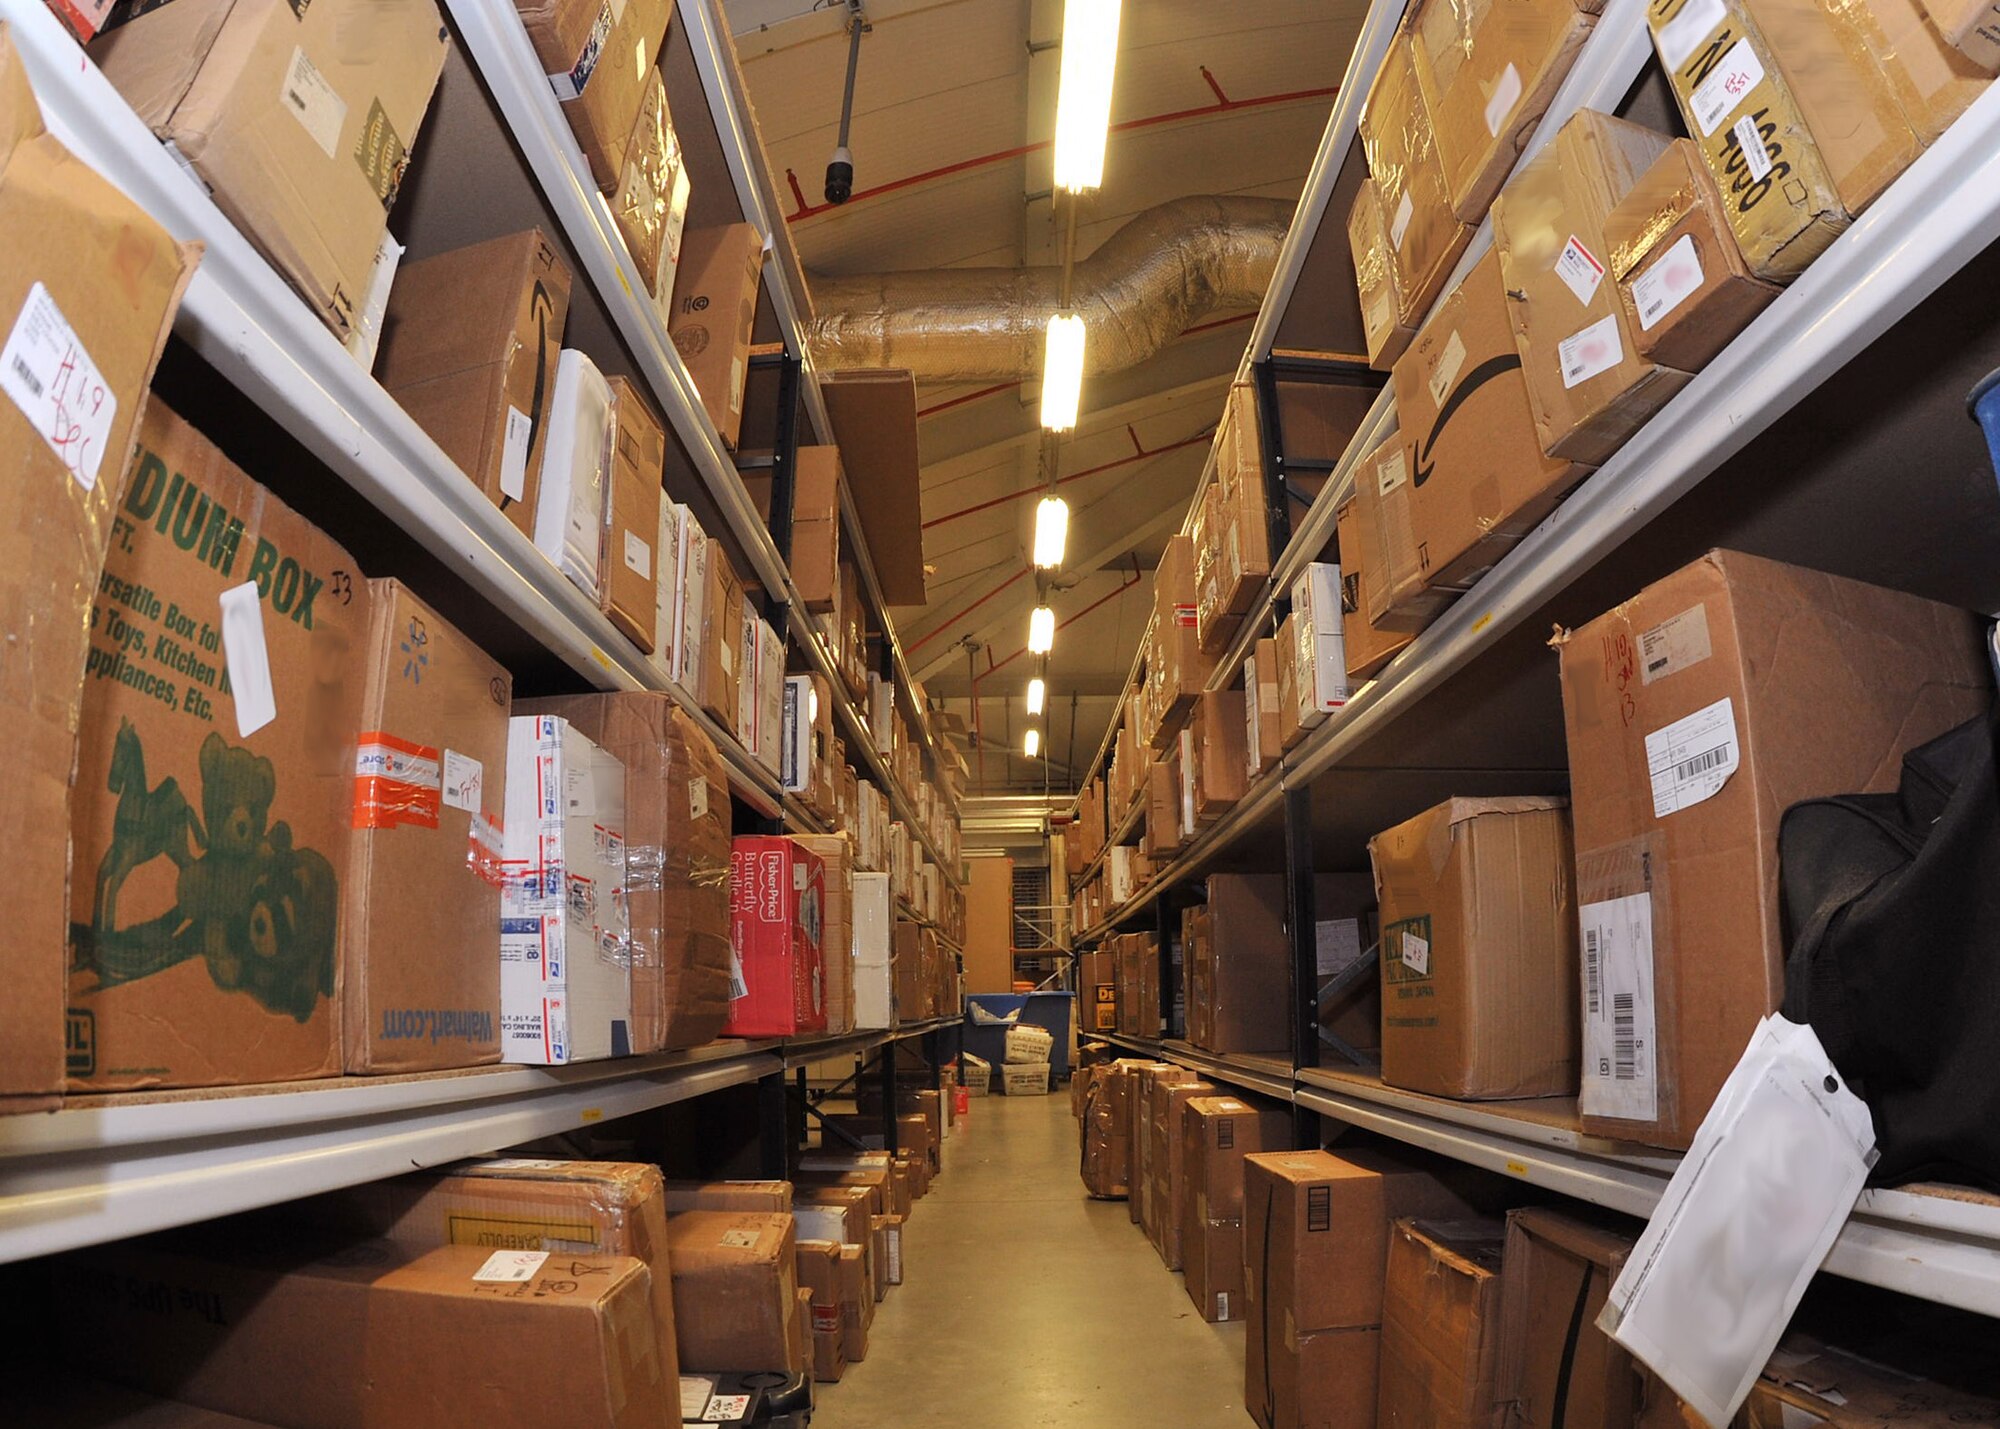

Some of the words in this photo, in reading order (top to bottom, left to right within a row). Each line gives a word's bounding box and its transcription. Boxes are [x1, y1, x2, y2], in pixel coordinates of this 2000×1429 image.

[125, 443, 245, 578] DIUM
[248, 536, 324, 631] BOX
[105, 608, 148, 659] Toys,
[153, 635, 216, 688] Kitchen
[164, 603, 196, 641] Box
[183, 687, 214, 721] Etc.
[729, 851, 742, 895] Cradle
[741, 852, 757, 913] Butterfly
[767, 855, 779, 919] Fisher-Price
[477, 1231, 540, 1250] CAREFULLY
